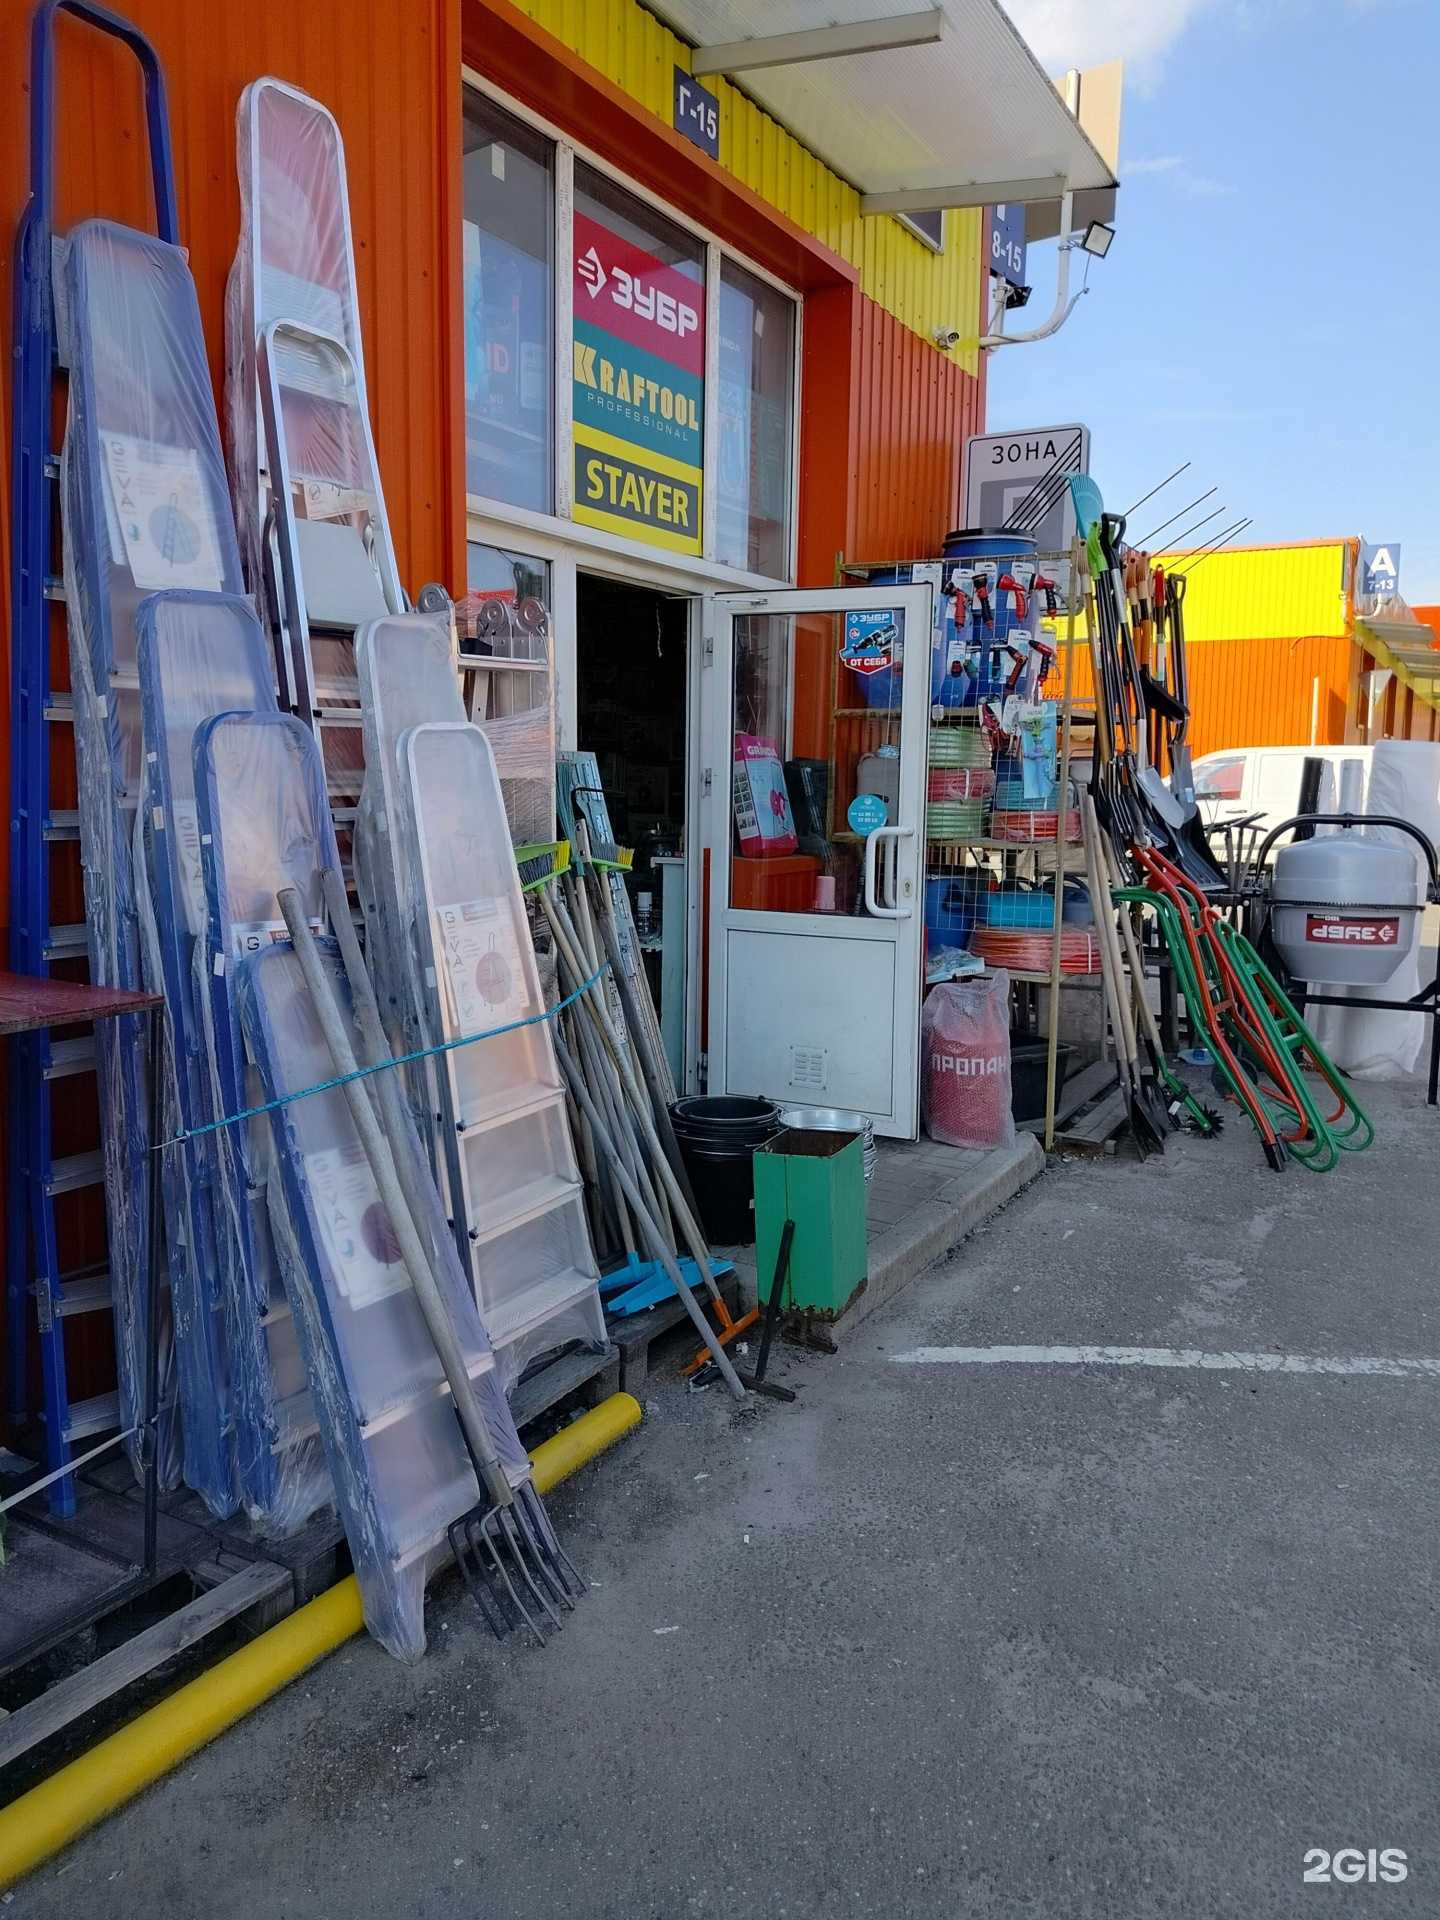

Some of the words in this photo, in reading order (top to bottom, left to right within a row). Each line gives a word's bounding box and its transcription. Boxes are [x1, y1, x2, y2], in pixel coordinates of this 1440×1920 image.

[680, 85, 717, 140] Г-15
[992, 230, 1023, 273] 8-15
[611, 266, 698, 338] ЗУБР
[573, 340, 699, 432] KRAFTOOL
[587, 392, 689, 442] PROFESSIONAL
[991, 440, 1058, 465] ЗОНА
[586, 459, 690, 527] STAYER
[1367, 579, 1394, 590] 7-13
[859, 613, 889, 622] ЗУБР
[850, 658, 862, 666] ОТ
[864, 657, 887, 666] СЕБЯ
[1312, 925, 1376, 940] ЗУБР
[932, 1053, 1008, 1076] ПРОПАН
